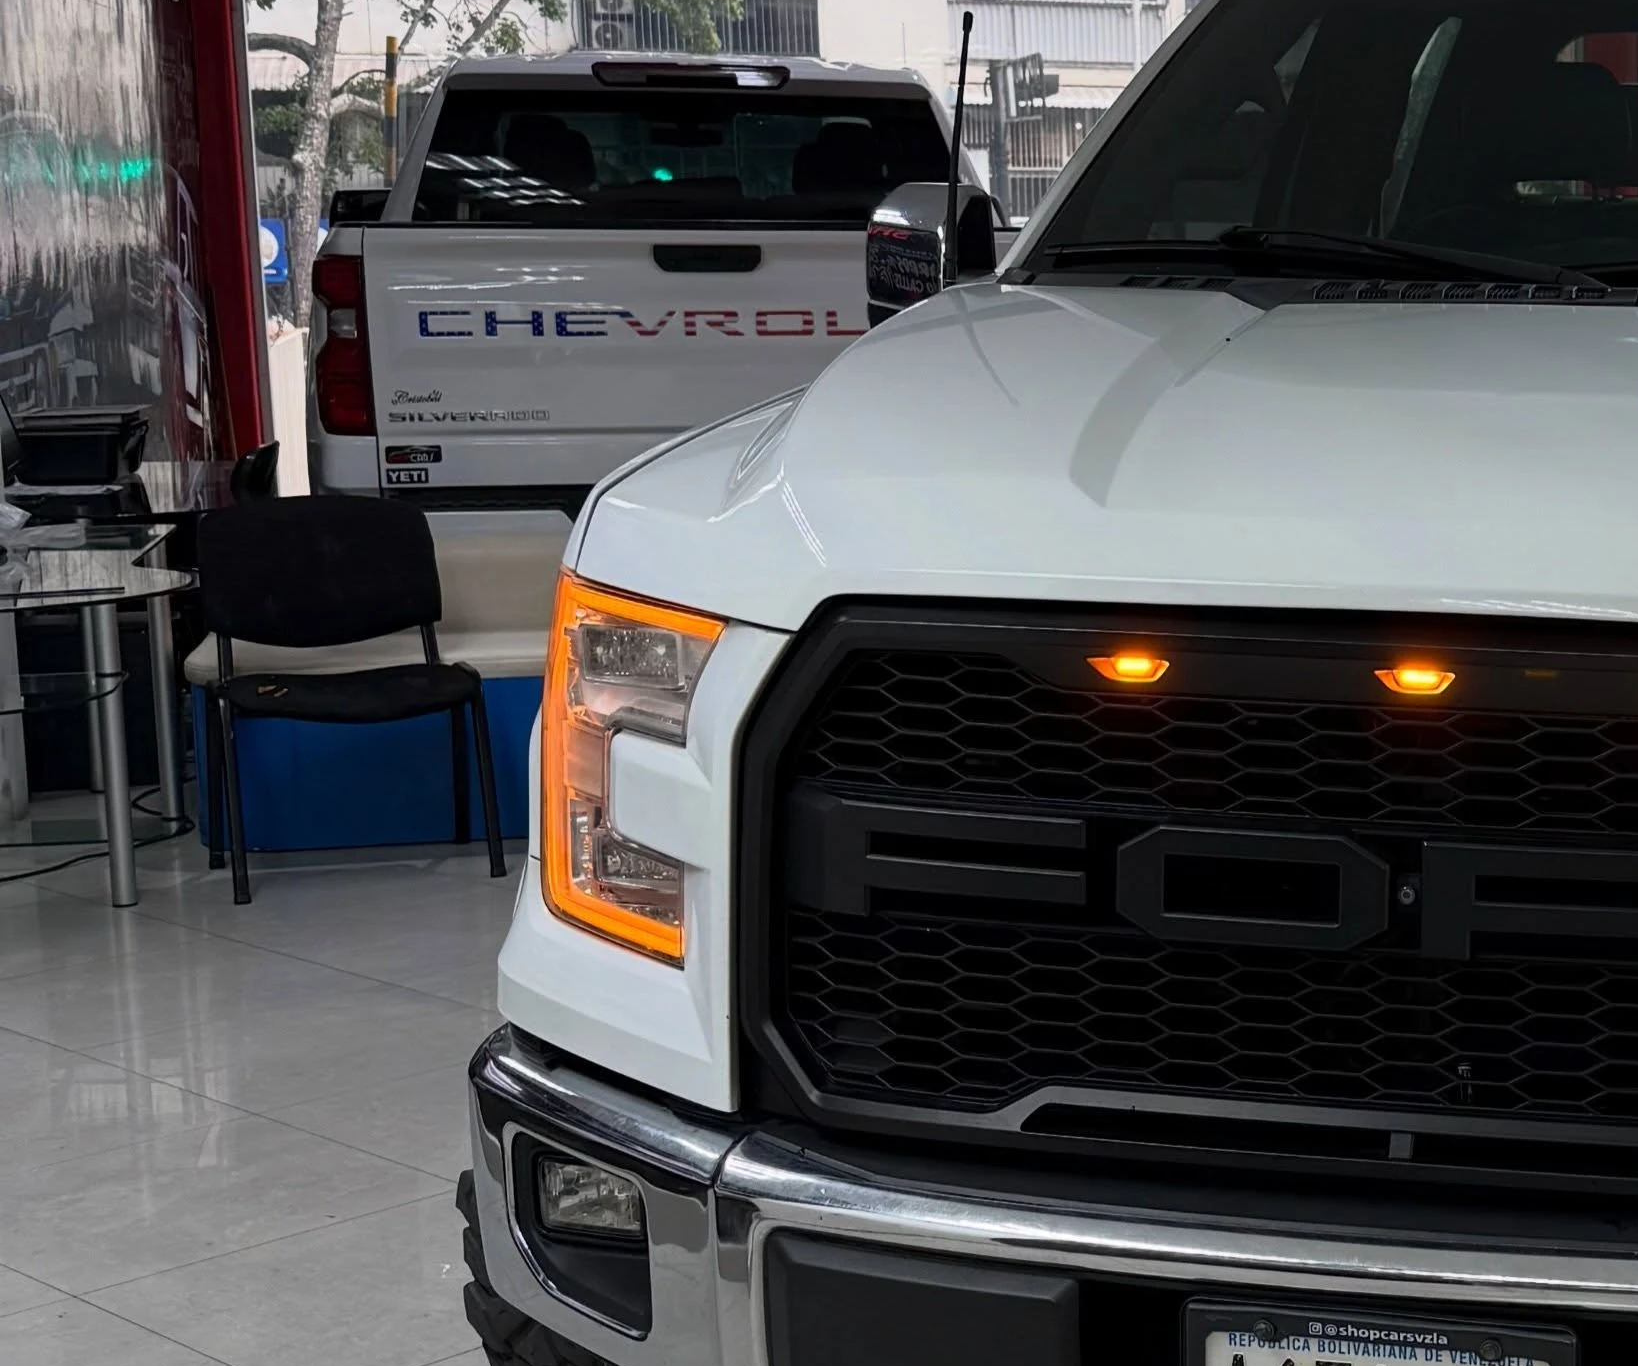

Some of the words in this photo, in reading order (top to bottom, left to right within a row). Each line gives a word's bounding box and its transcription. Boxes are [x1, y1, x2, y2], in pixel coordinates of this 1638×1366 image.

[388, 409, 550, 423] SILVERADO
[388, 470, 426, 483] YETI
[1324, 1323, 1448, 1345] @shopcarsvzla
[1317, 1340, 1418, 1362] BOLIVARIANA
[1424, 1348, 1443, 1362] DE
